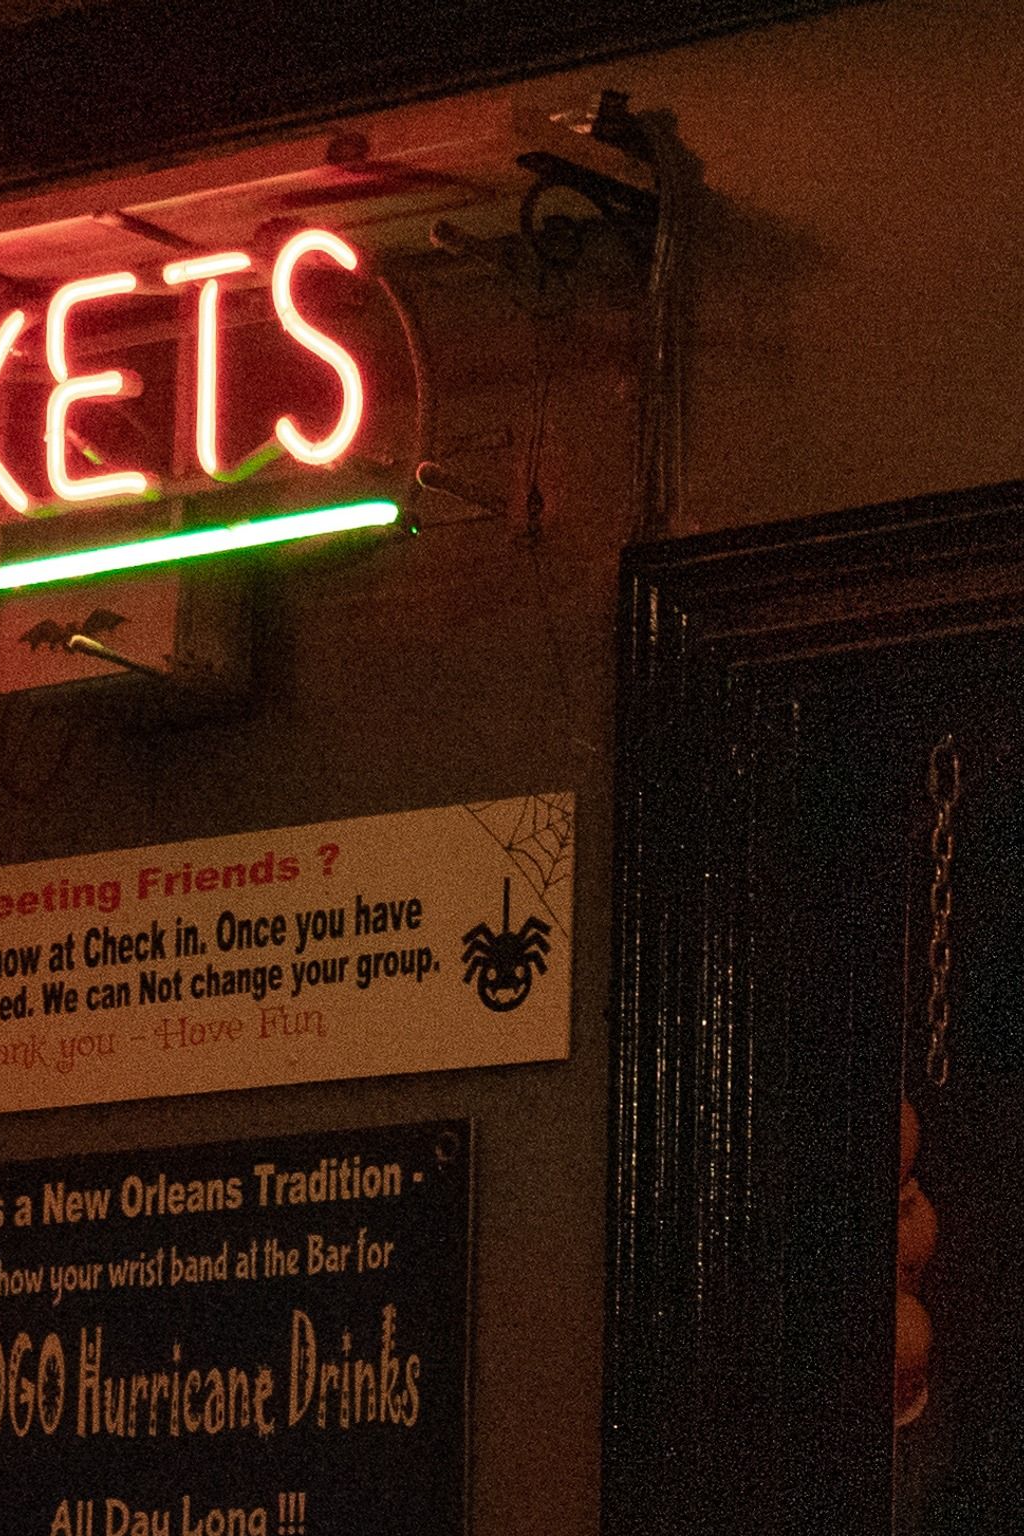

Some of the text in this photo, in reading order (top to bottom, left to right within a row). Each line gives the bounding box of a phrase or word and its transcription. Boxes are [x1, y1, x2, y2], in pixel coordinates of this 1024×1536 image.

[137, 852, 301, 900] Friends
[319, 843, 340, 877] ?
[49, 933, 75, 973] at
[84, 920, 167, 968] Check
[176, 917, 207, 957] in.
[216, 910, 286, 952] Once
[295, 907, 345, 954] you
[355, 895, 423, 936] have
[42, 980, 78, 1015] We
[86, 980, 131, 1012] can
[139, 969, 183, 1005] Not
[190, 962, 282, 1001] change
[291, 955, 350, 997] your
[356, 945, 441, 990] group.
[57, 1033, 116, 1075] you
[153, 1015, 244, 1051] Have
[259, 1004, 326, 1039] Fun
[13, 1195, 33, 1227] a
[42, 1180, 112, 1225] New
[120, 1170, 244, 1219] Orleans
[254, 1154, 404, 1207] Tradition
[50, 1259, 103, 1308] your
[108, 1247, 167, 1290] wrist
[169, 1240, 229, 1283] band
[234, 1235, 258, 1280] at
[262, 1236, 300, 1277] the
[306, 1233, 353, 1273] Bar
[355, 1226, 394, 1273] for
[77, 1324, 276, 1440] Hurricane
[287, 1302, 422, 1430] Drinks
[277, 1491, 307, 1536] !!!
